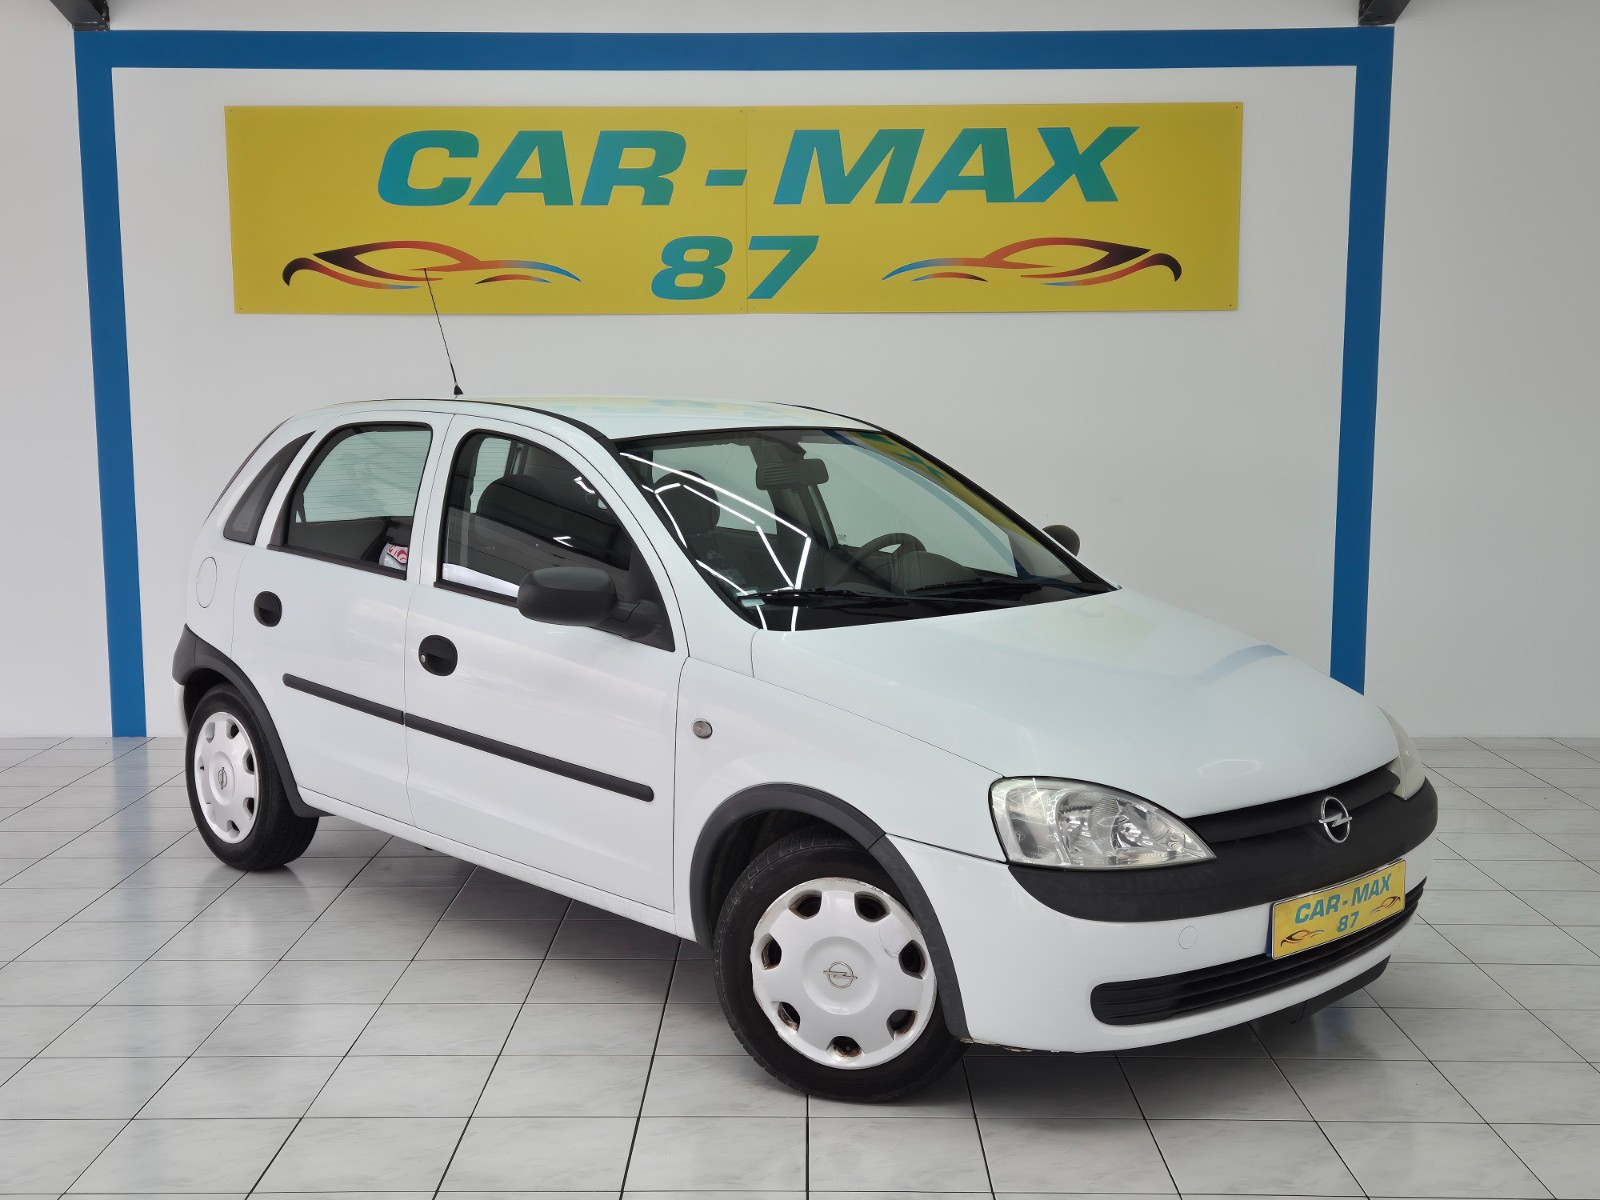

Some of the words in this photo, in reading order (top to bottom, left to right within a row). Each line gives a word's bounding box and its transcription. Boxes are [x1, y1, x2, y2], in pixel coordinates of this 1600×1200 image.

[377, 129, 687, 206] CAR
[773, 126, 1140, 205] MAX
[651, 235, 819, 300] 87
[1295, 894, 1341, 924] CAR
[1351, 873, 1392, 907] MAX
[1336, 911, 1359, 933] 87
